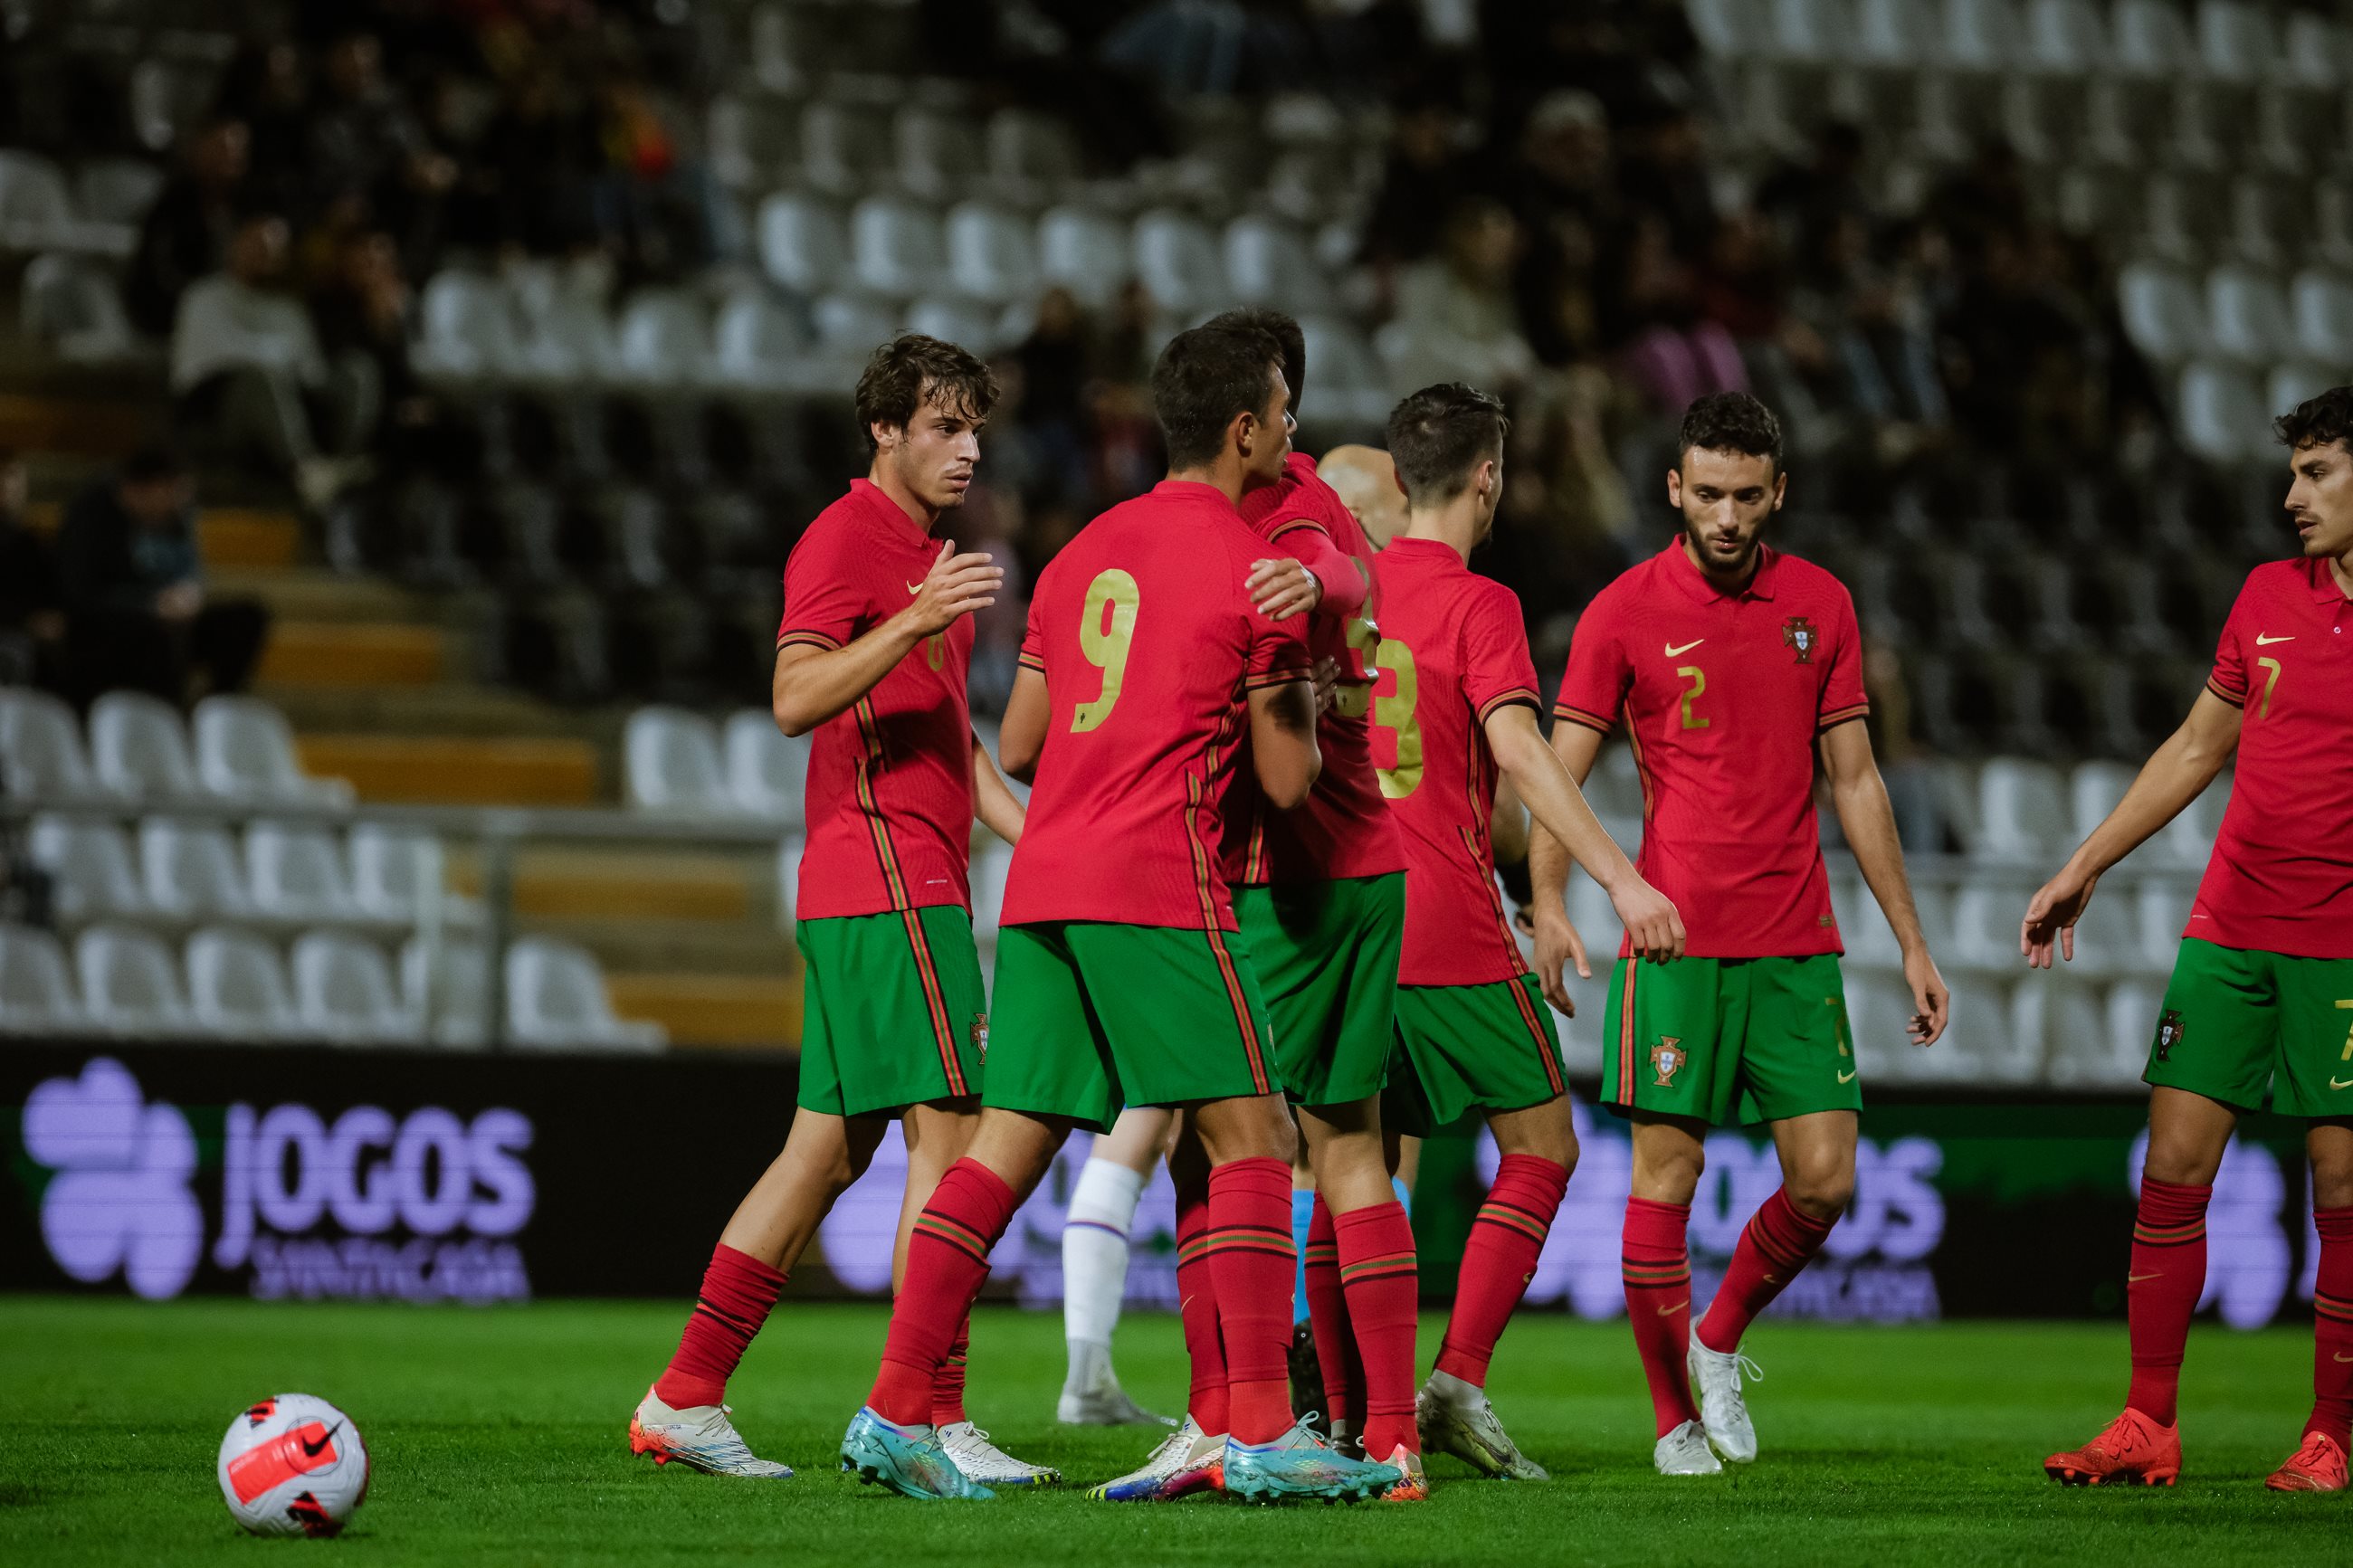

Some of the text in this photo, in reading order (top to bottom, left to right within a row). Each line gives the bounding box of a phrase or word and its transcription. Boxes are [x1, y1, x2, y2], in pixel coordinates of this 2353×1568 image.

[1070, 568, 1139, 733] 9
[1375, 637, 1424, 799] 3
[1677, 666, 1710, 729] 2
[2258, 657, 2281, 719] 7
[214, 1101, 536, 1268] JOGOS
